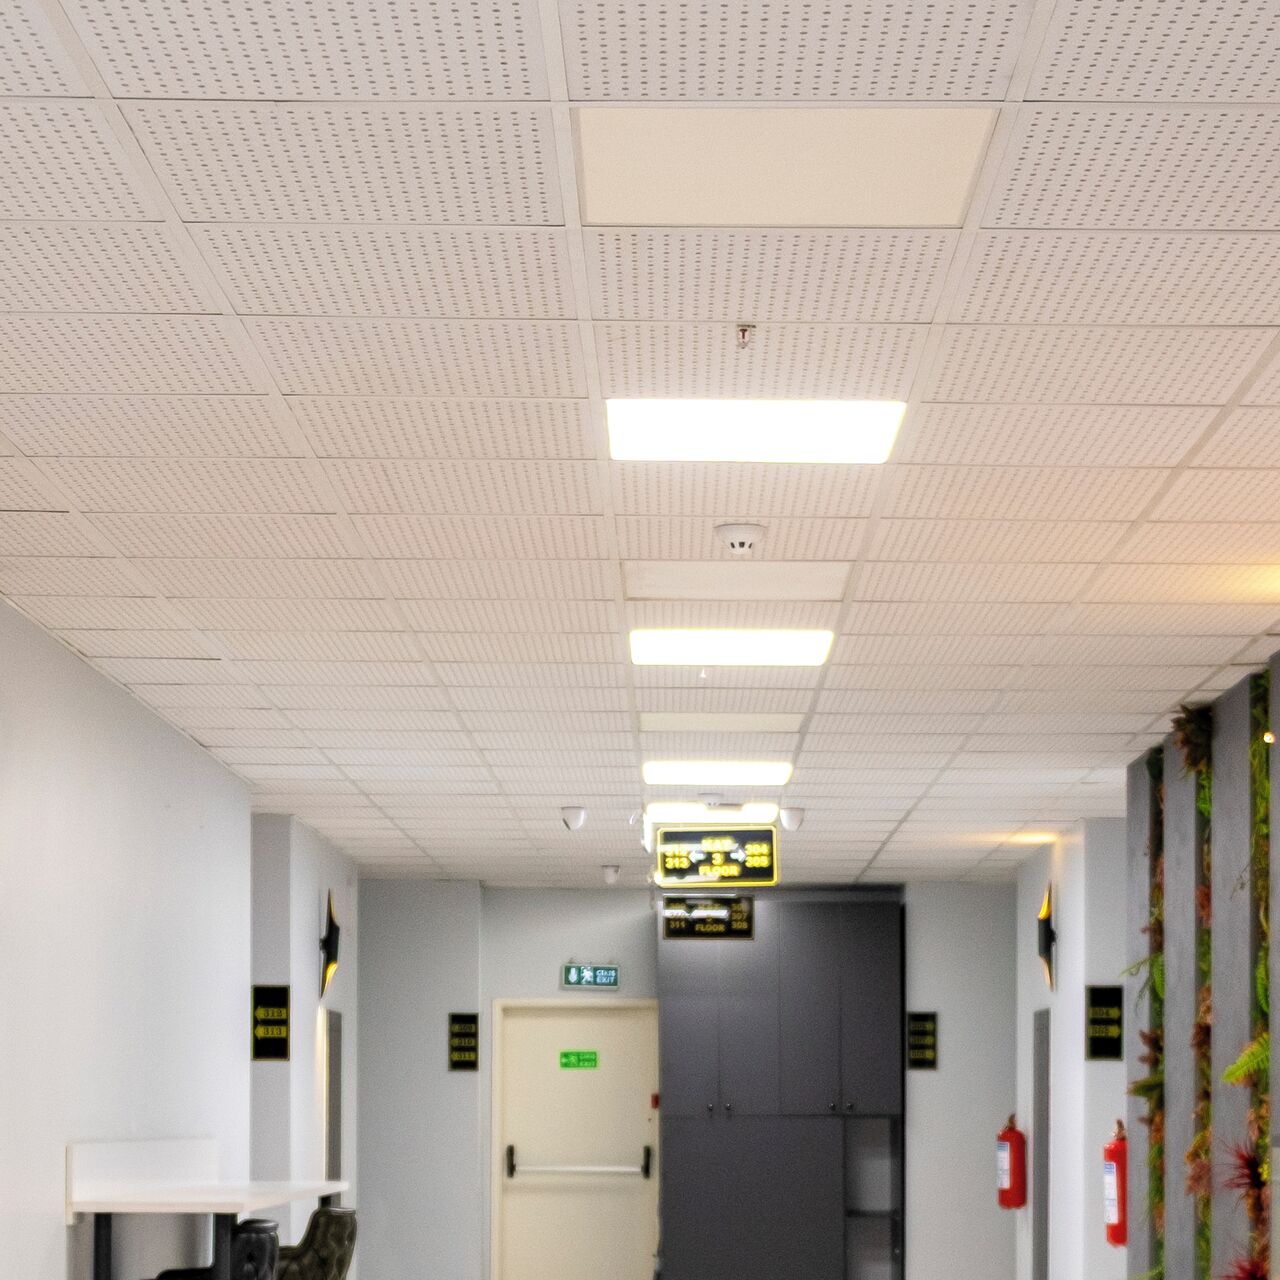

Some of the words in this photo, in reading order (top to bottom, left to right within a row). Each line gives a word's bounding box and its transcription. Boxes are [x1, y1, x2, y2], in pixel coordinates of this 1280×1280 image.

[665, 857, 690, 869] 313
[712, 853, 723, 865] 3
[745, 856, 768, 868] 305
[699, 865, 739, 876] FLOOR
[695, 923, 726, 932] FLOOR
[596, 976, 615, 984] EXIT
